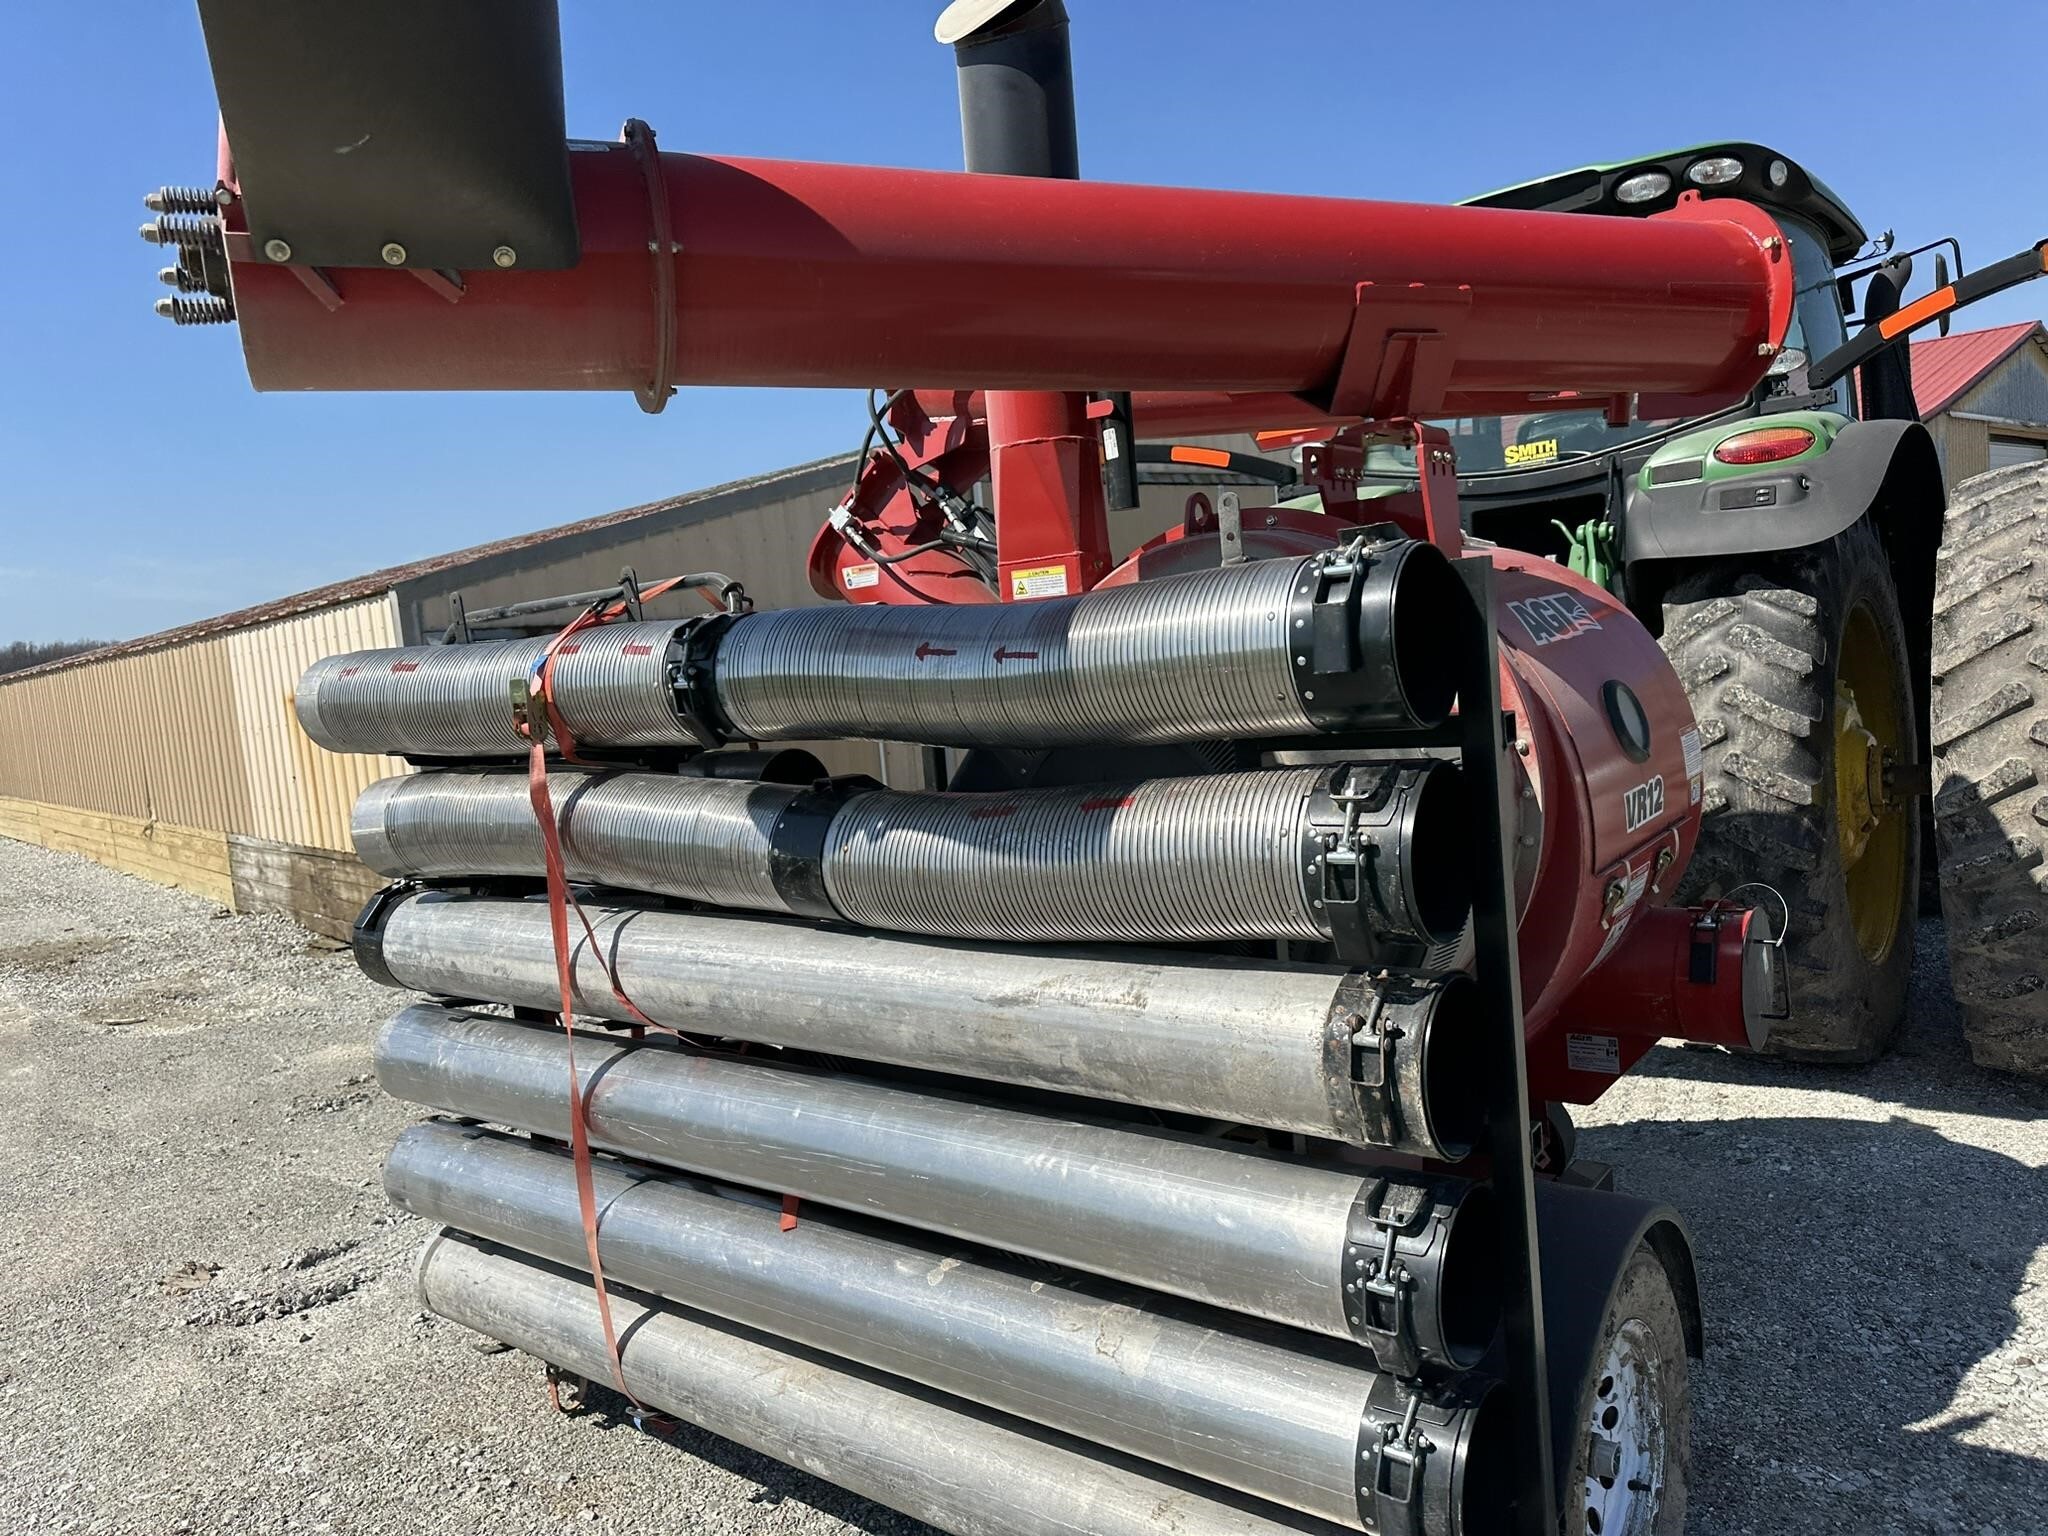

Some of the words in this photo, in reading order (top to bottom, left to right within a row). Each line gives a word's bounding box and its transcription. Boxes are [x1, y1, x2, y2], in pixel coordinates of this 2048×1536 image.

[1504, 439, 1557, 464] SMITH
[1507, 597, 1585, 645] AGI
[1624, 775, 1664, 832] VR12
